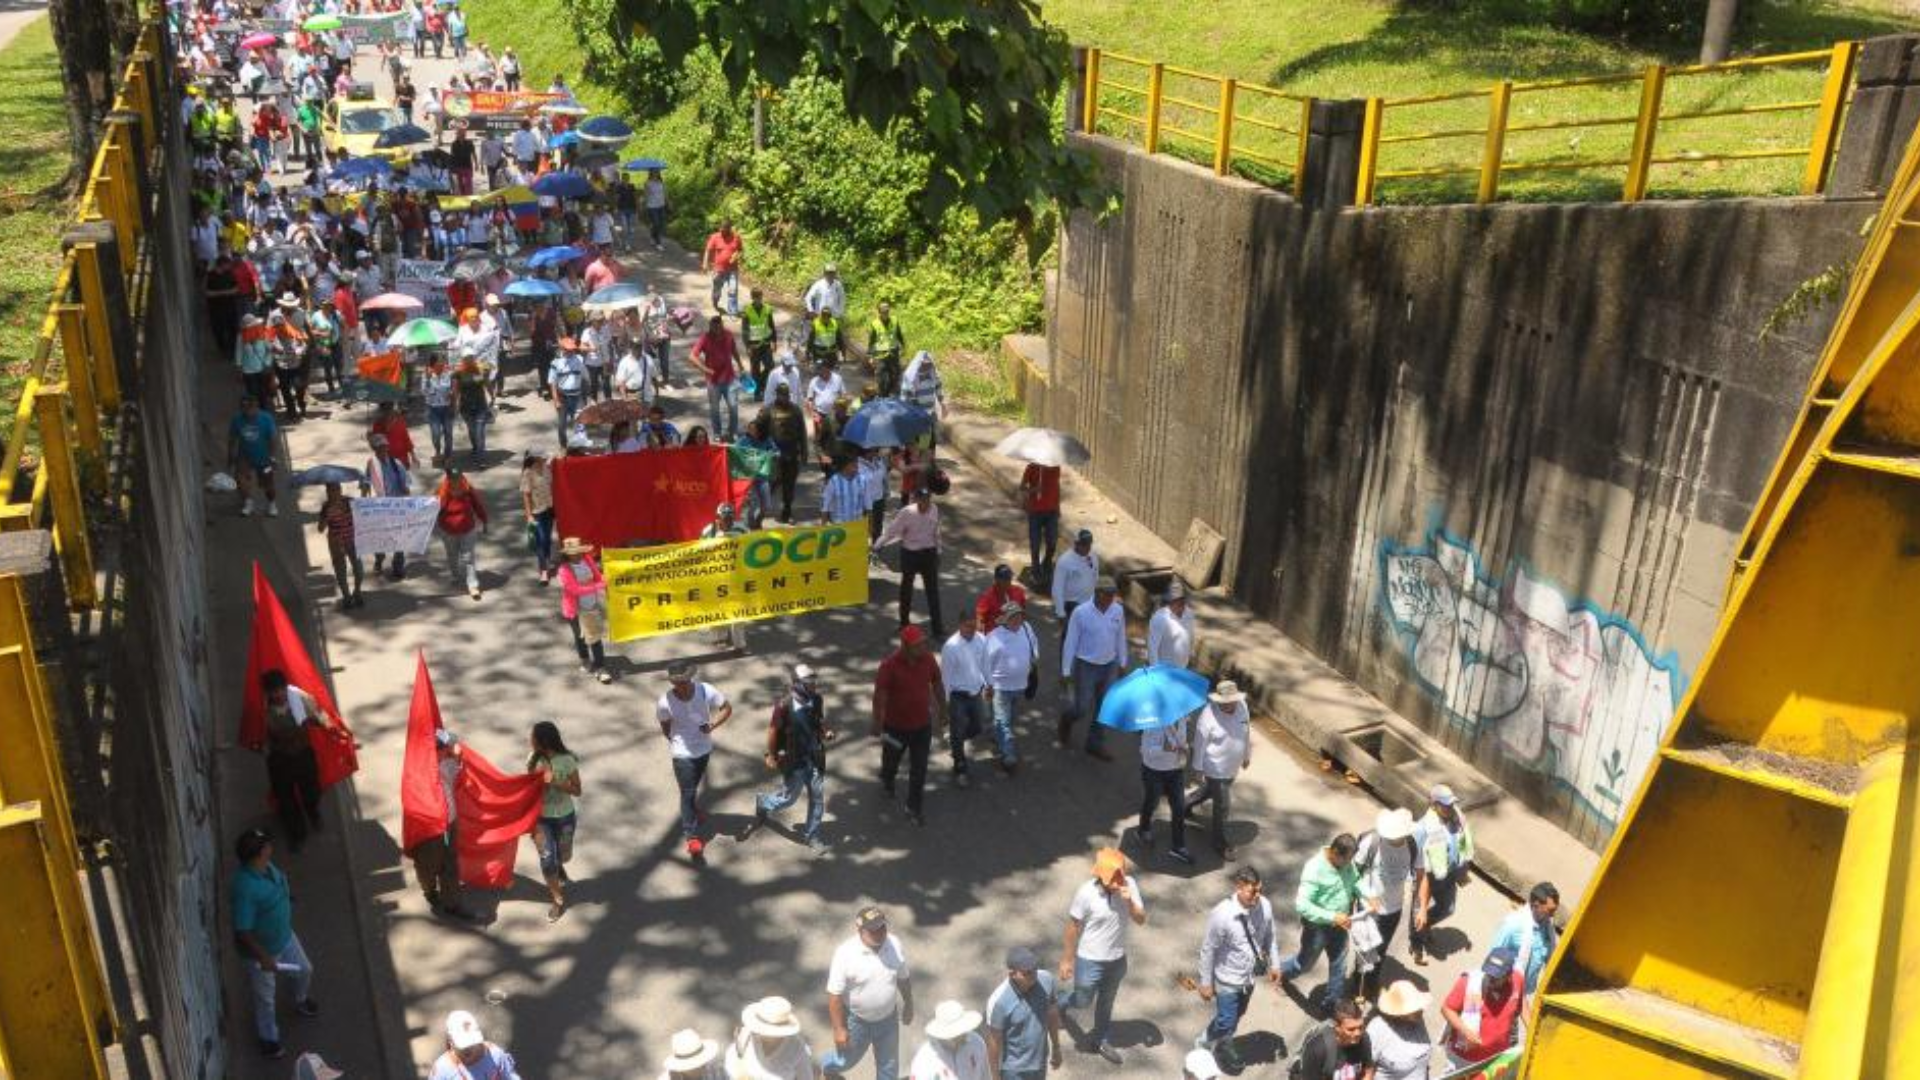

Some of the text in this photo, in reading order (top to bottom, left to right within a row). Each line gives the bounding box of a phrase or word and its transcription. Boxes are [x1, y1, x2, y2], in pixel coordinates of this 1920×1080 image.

[643, 553, 737, 571] COLOMBIANA
[744, 528, 846, 569] OCP
[615, 563, 736, 587] DE PENSIONADOS
[627, 568, 840, 610] PRESENTE
[657, 596, 827, 631] SECCIONAL VILLAVICENCIO
